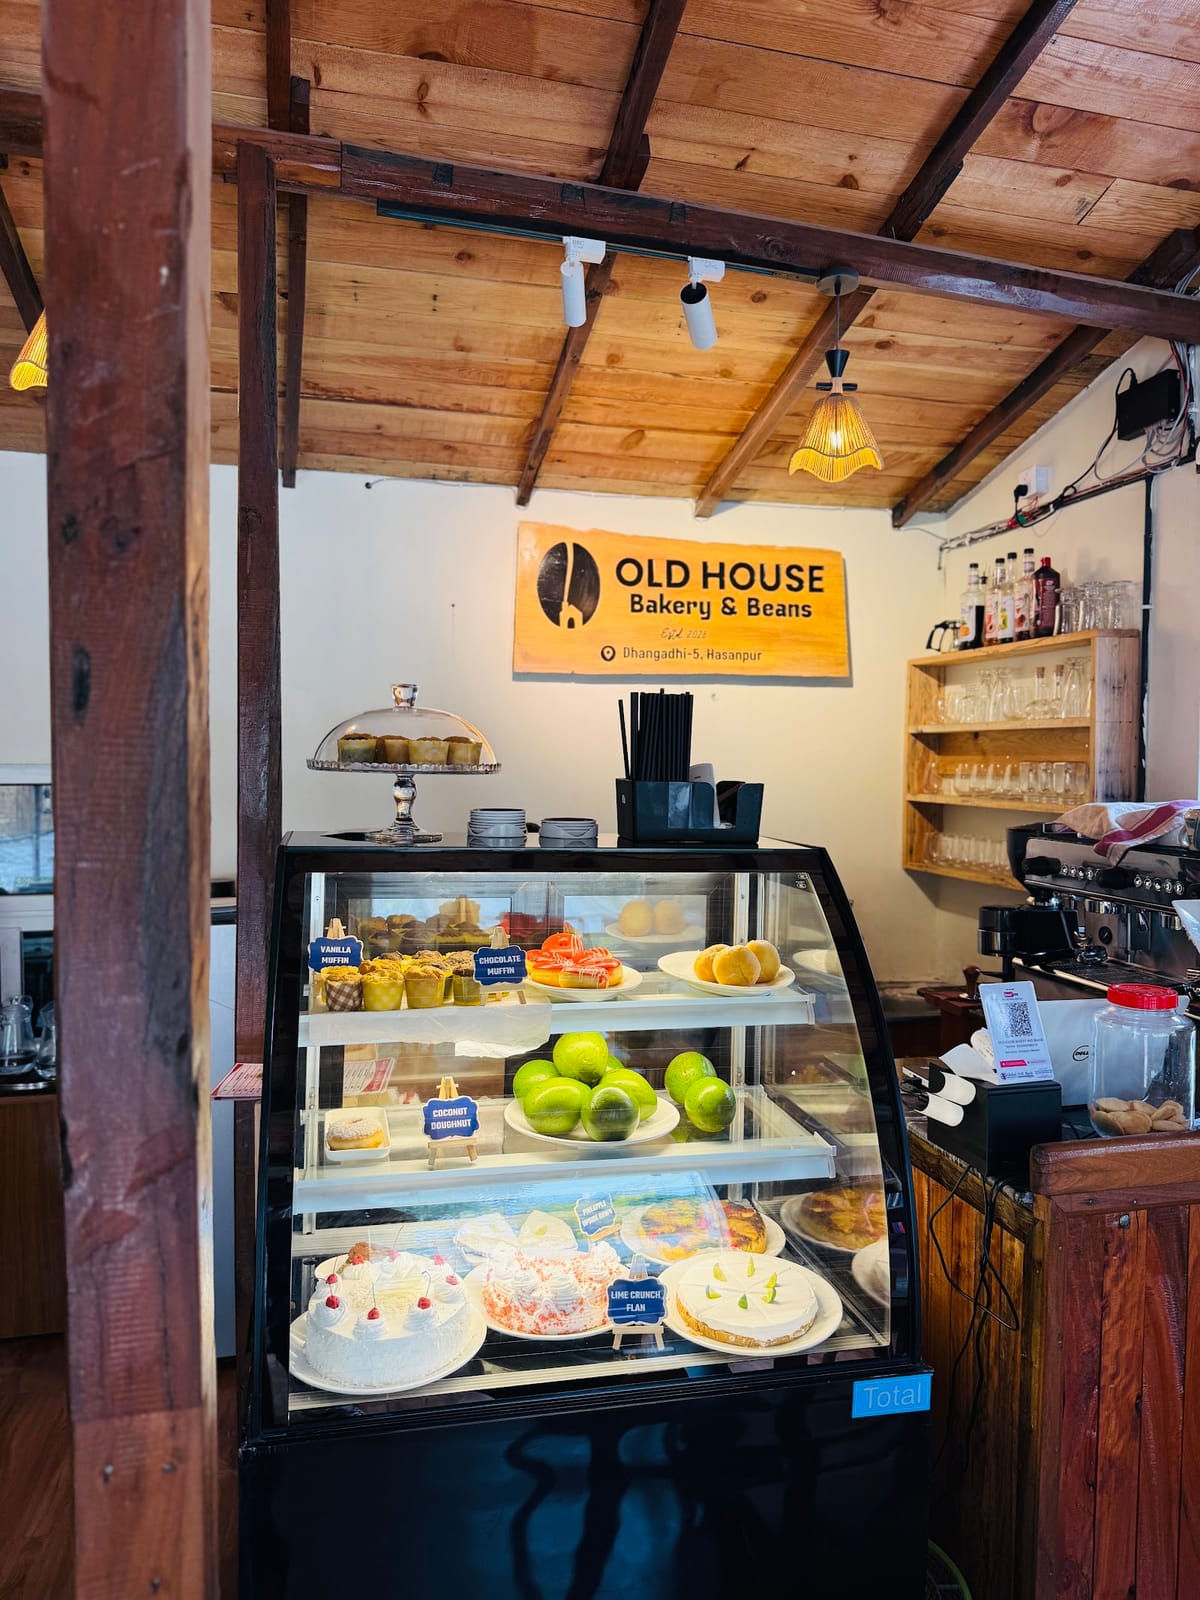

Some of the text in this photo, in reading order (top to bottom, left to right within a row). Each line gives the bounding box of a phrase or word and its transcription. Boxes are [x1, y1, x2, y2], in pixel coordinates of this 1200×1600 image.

[615, 557, 825, 593] OLD HOUSE
[630, 593, 813, 620] Bakery & Beans
[706, 649, 762, 662] Hasanpur
[320, 945, 352, 954] VANILLA
[321, 956, 350, 964] MUFFIN
[479, 954, 521, 965] CHOCOLATE
[487, 966, 515, 976] MUFFIN
[432, 1107, 468, 1118] COCONUT
[430, 1118, 472, 1130] DOUGHNUT
[611, 1290, 661, 1299] LIME CRUNCH
[626, 1303, 646, 1312] FLAN
[863, 1382, 922, 1409] Total
